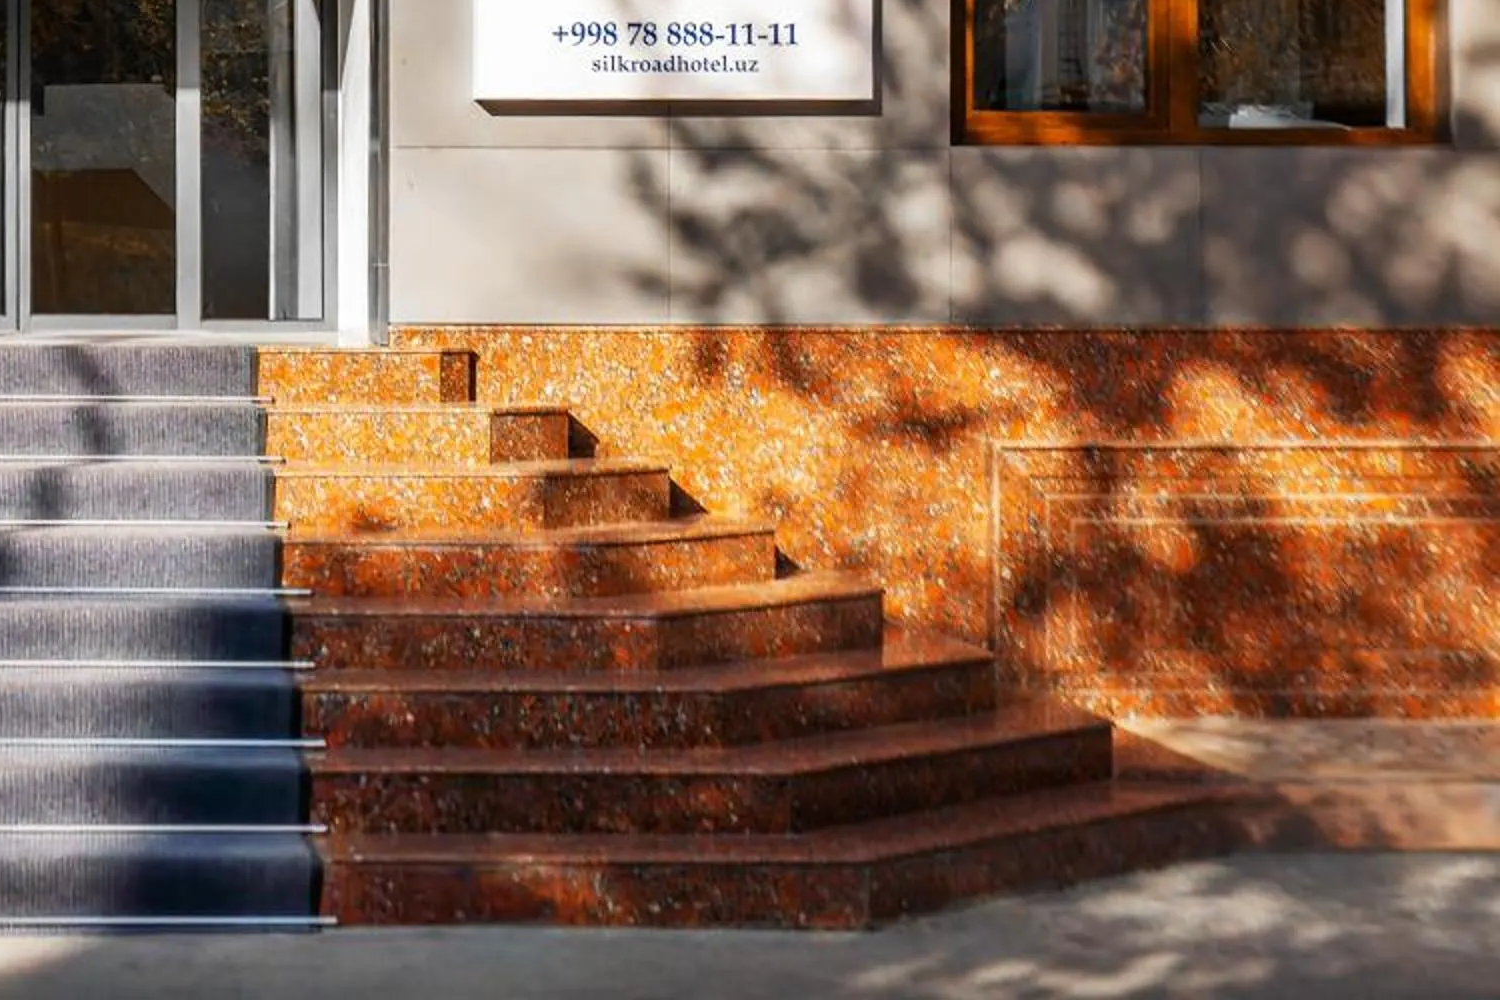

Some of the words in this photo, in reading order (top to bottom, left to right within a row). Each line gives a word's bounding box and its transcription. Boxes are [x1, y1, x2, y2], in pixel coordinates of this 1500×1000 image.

[552, 22, 617, 47] +998
[627, 22, 658, 47] 78
[667, 22, 798, 47] 888-11-11
[591, 55, 759, 74] silkroadhotel.uz
